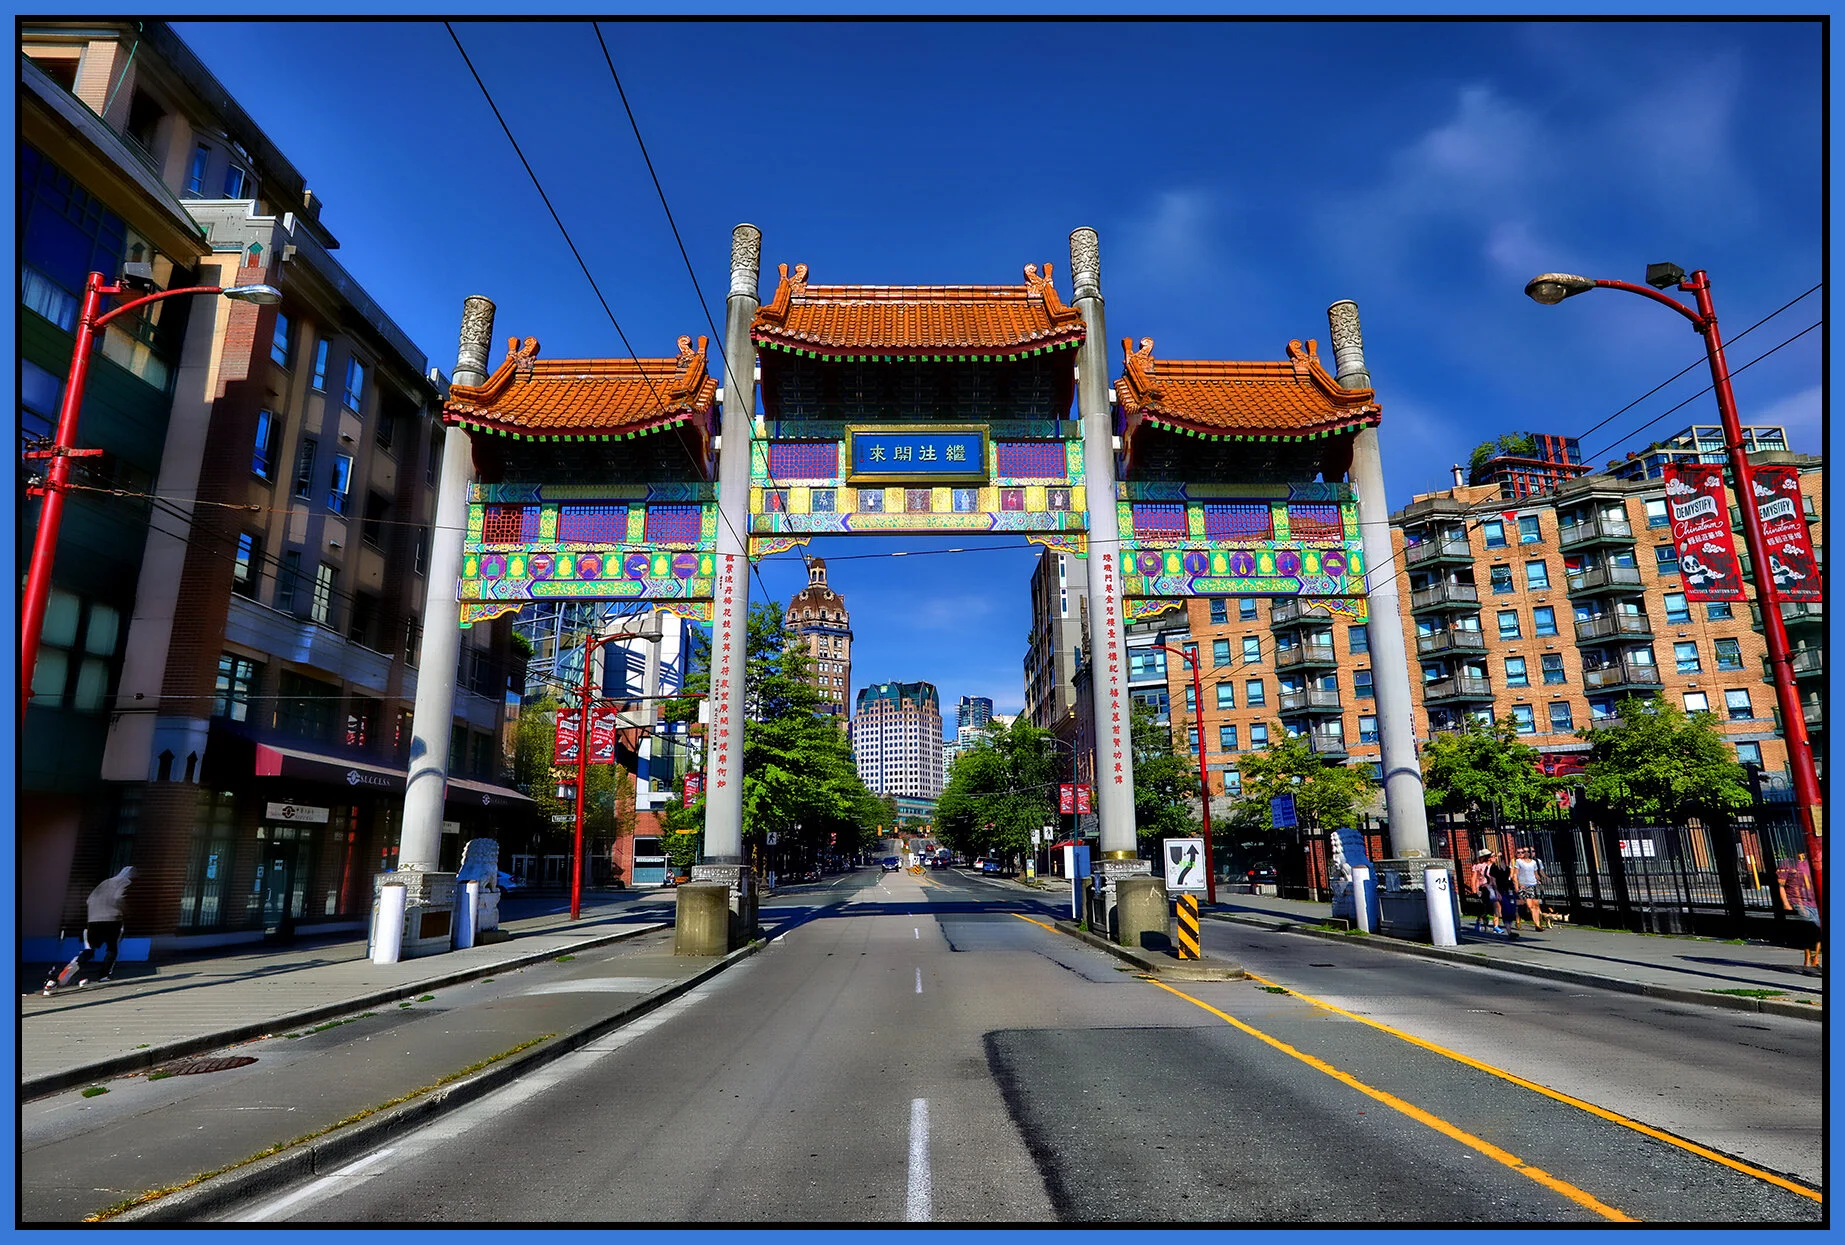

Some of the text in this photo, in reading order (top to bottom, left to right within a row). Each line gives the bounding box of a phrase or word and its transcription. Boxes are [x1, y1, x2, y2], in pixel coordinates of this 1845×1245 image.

[1676, 499, 1712, 519] DEMYSTIFY
[1674, 518, 1724, 539] Chinatown
[1761, 519, 1802, 536] hinatown
